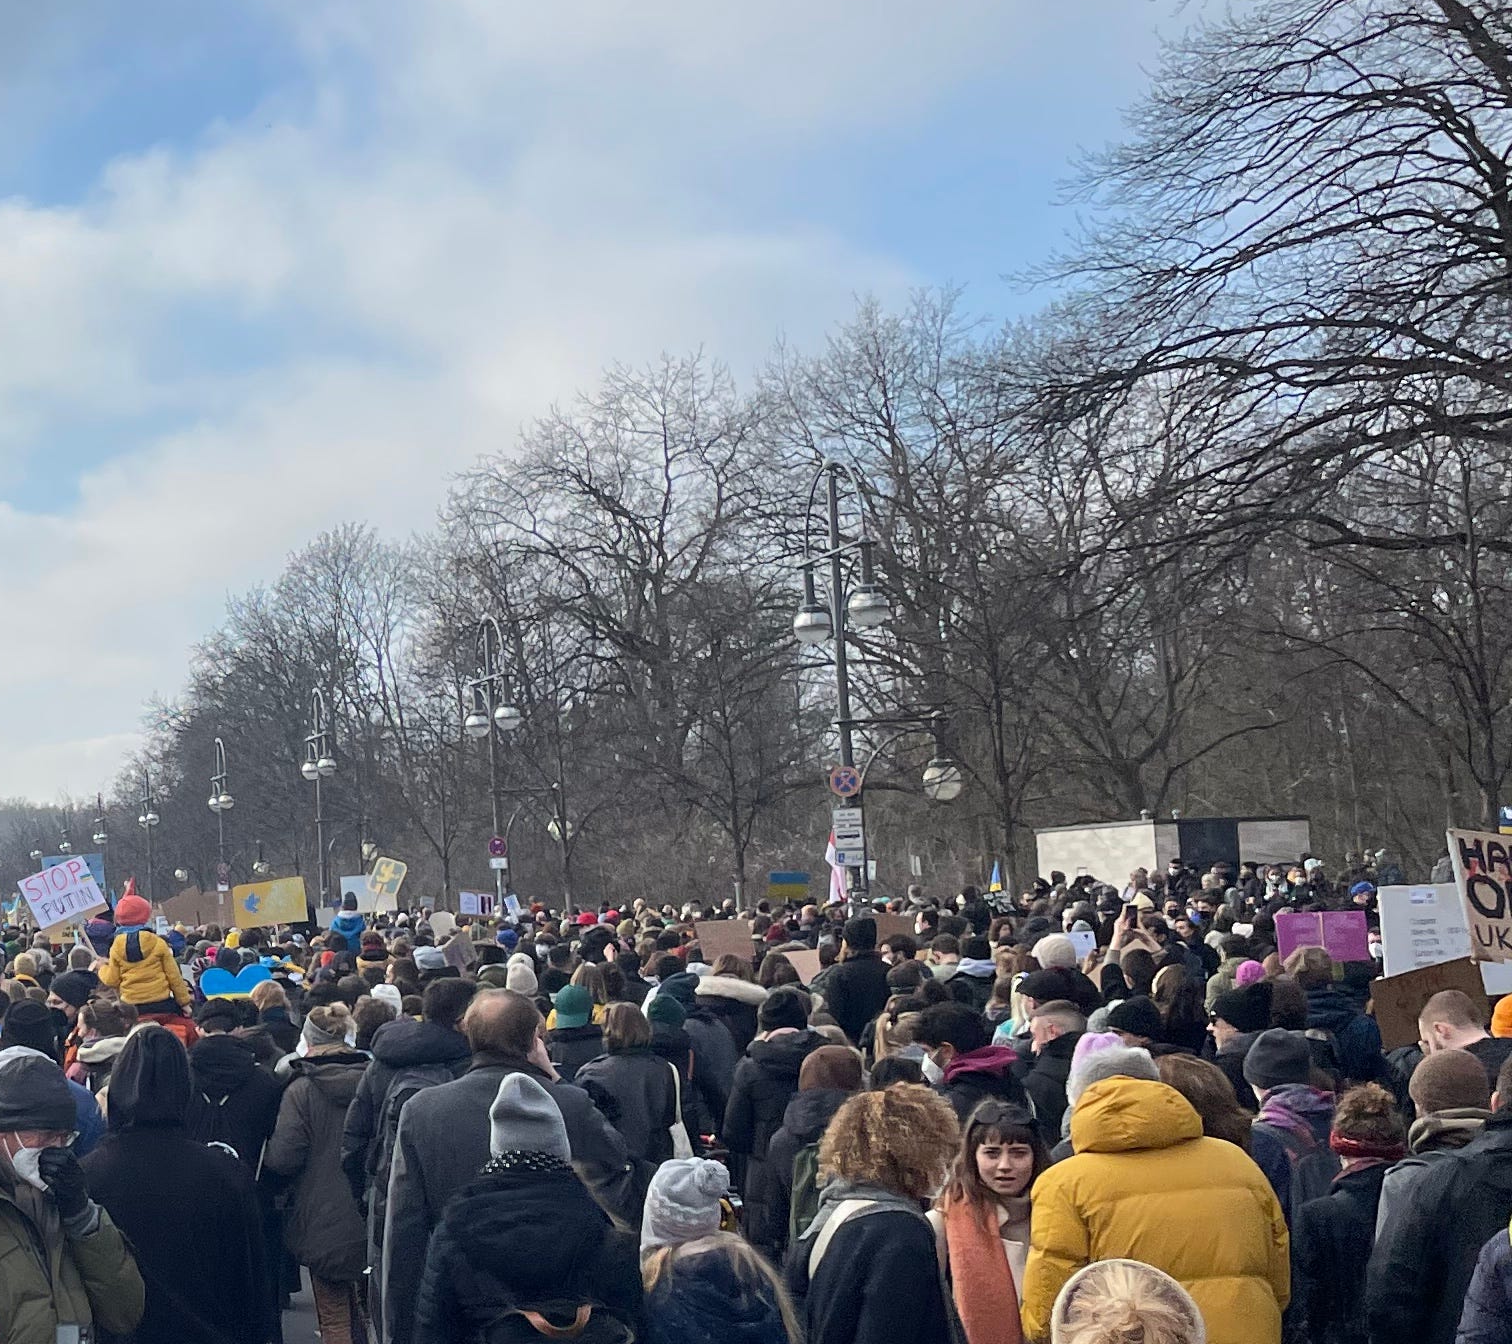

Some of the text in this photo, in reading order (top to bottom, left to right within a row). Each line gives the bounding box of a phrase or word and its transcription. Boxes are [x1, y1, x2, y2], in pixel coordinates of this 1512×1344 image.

[1458, 838, 1512, 873] HA
[25, 861, 81, 902] STOP
[1467, 874, 1512, 918] O
[41, 887, 96, 920] PUTIN
